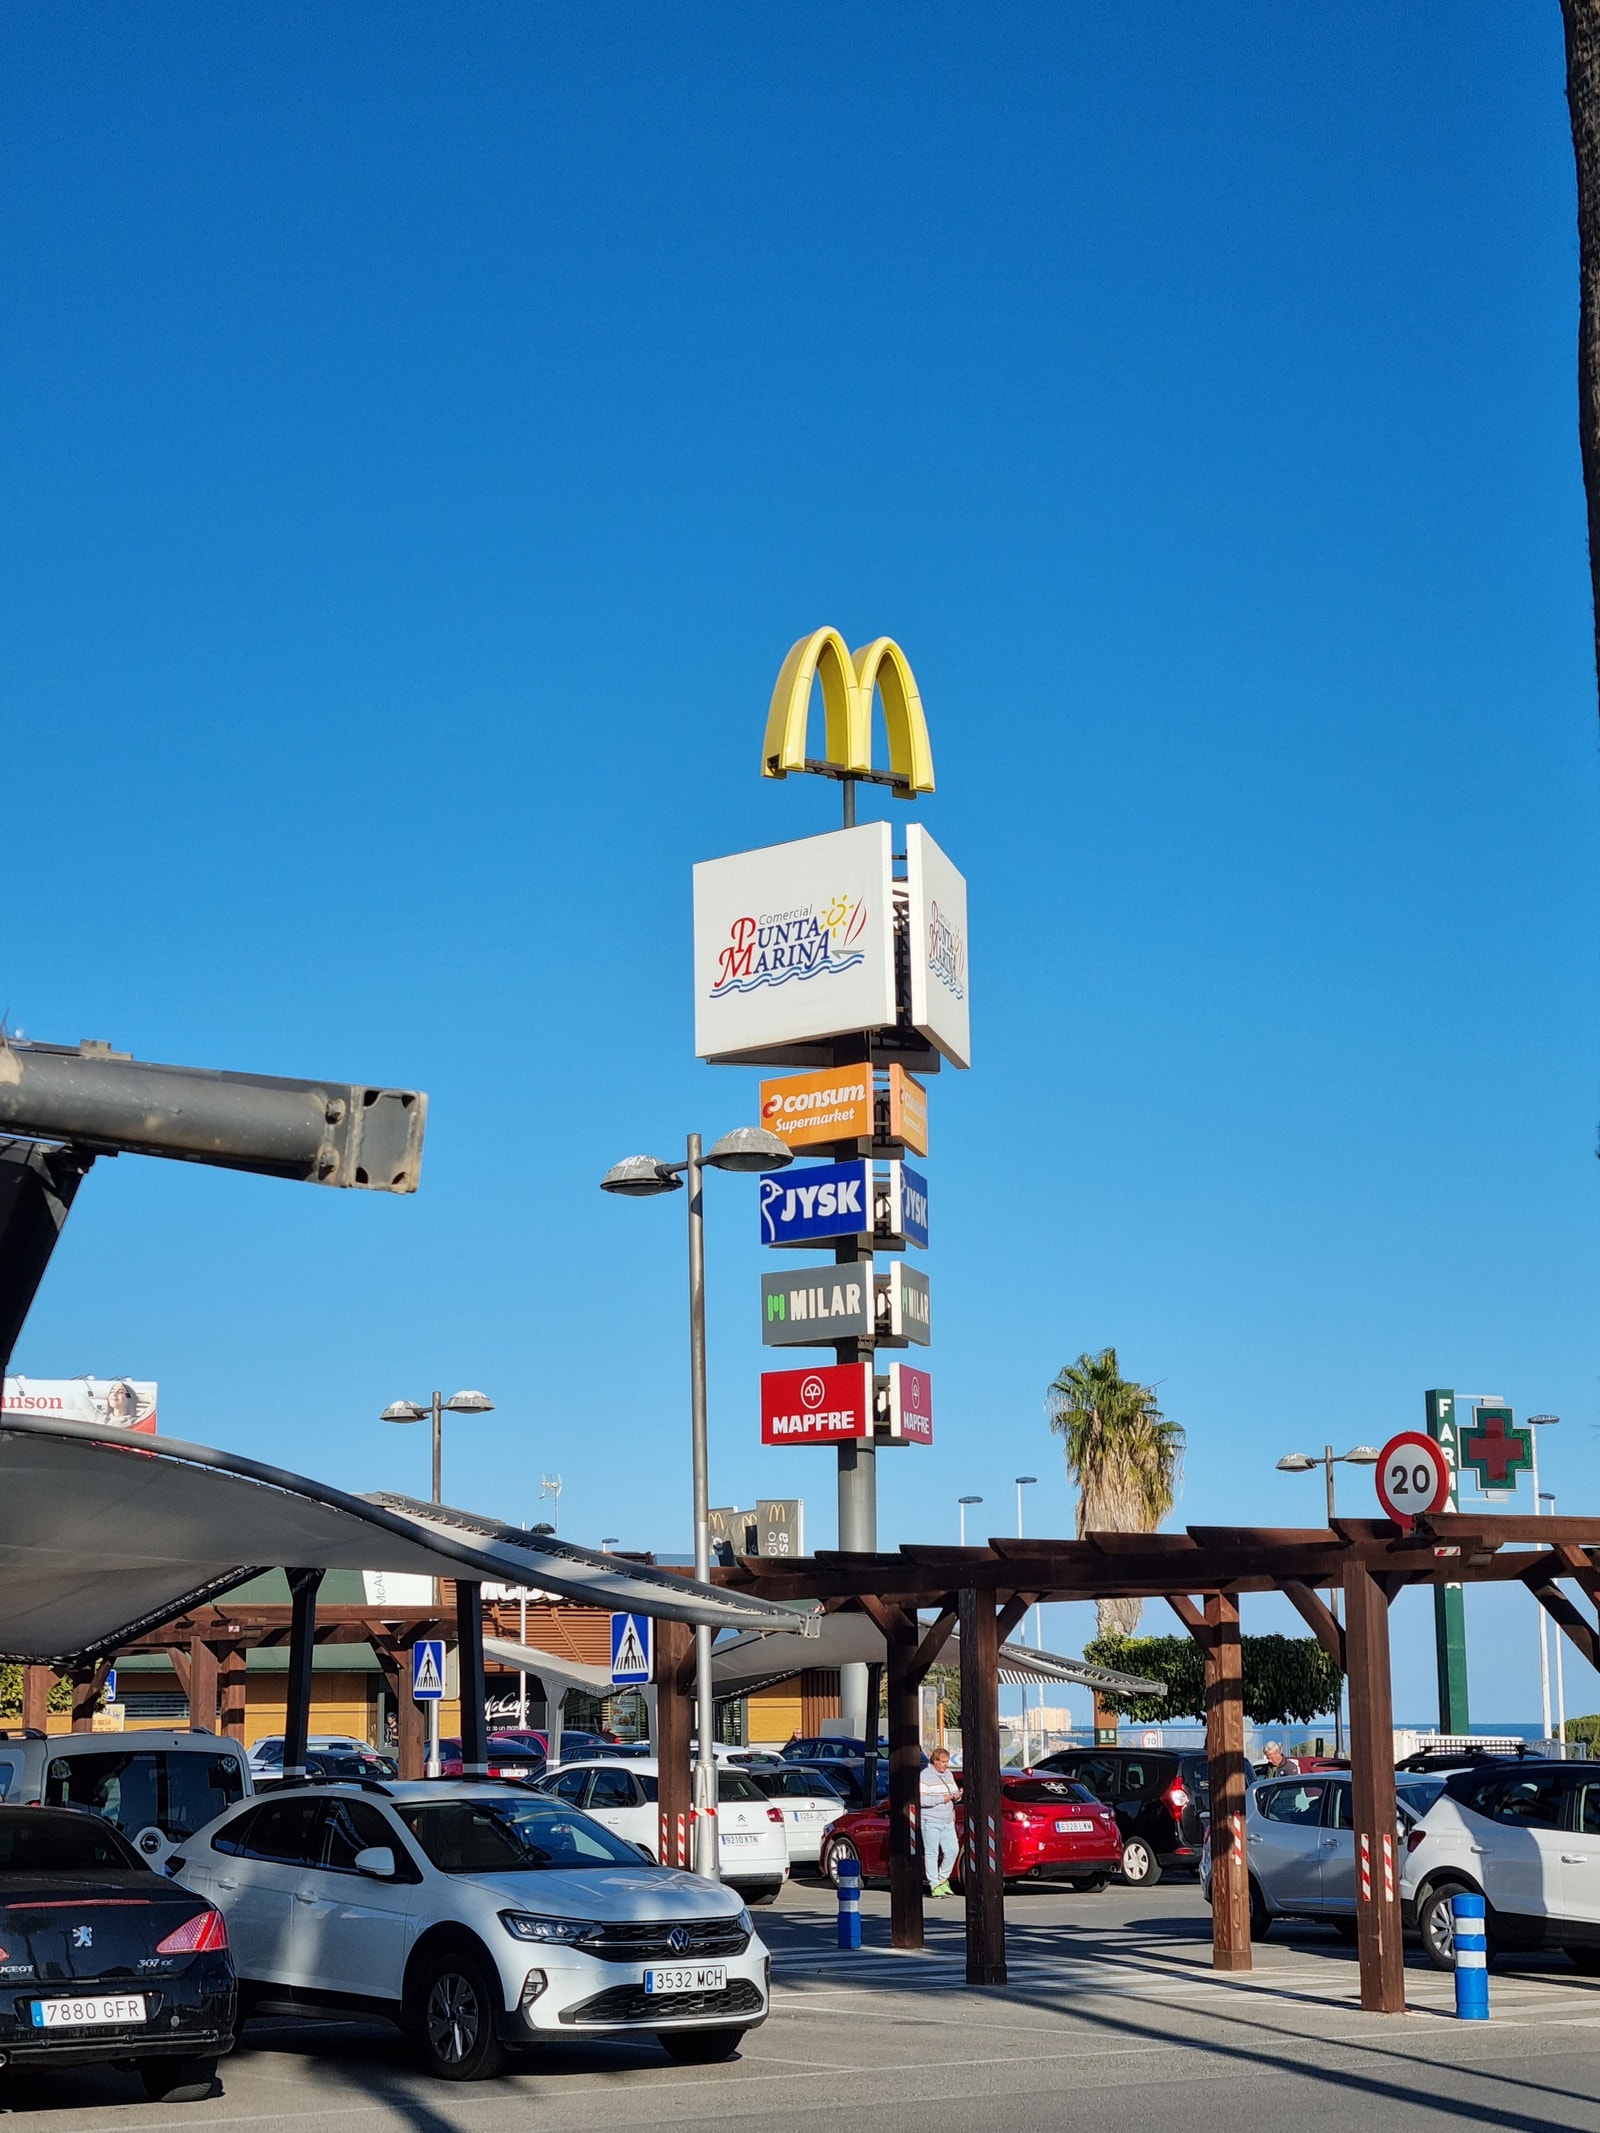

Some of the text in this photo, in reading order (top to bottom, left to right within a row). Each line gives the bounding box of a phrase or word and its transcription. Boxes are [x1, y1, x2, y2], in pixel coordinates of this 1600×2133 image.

[759, 904, 813, 926] Comercial
[731, 916, 821, 953] PUNTA
[714, 929, 830, 987] MARINA
[783, 1083, 866, 1113] consum
[775, 1108, 855, 1133] Supermarket
[780, 1180, 862, 1222] JYSK
[905, 1187, 928, 1229] JYSK
[790, 1283, 861, 1321] MILAR
[772, 1410, 855, 1435] MAPFRE
[903, 1411, 930, 1435] MAPFRE
[1391, 1464, 1431, 1495] 20
[725, 1835, 744, 1845] 9210
[137, 1958, 160, 1969] 307
[656, 1969, 723, 1989] 3532 MCH
[47, 2000, 139, 2022] 7880 GFR
